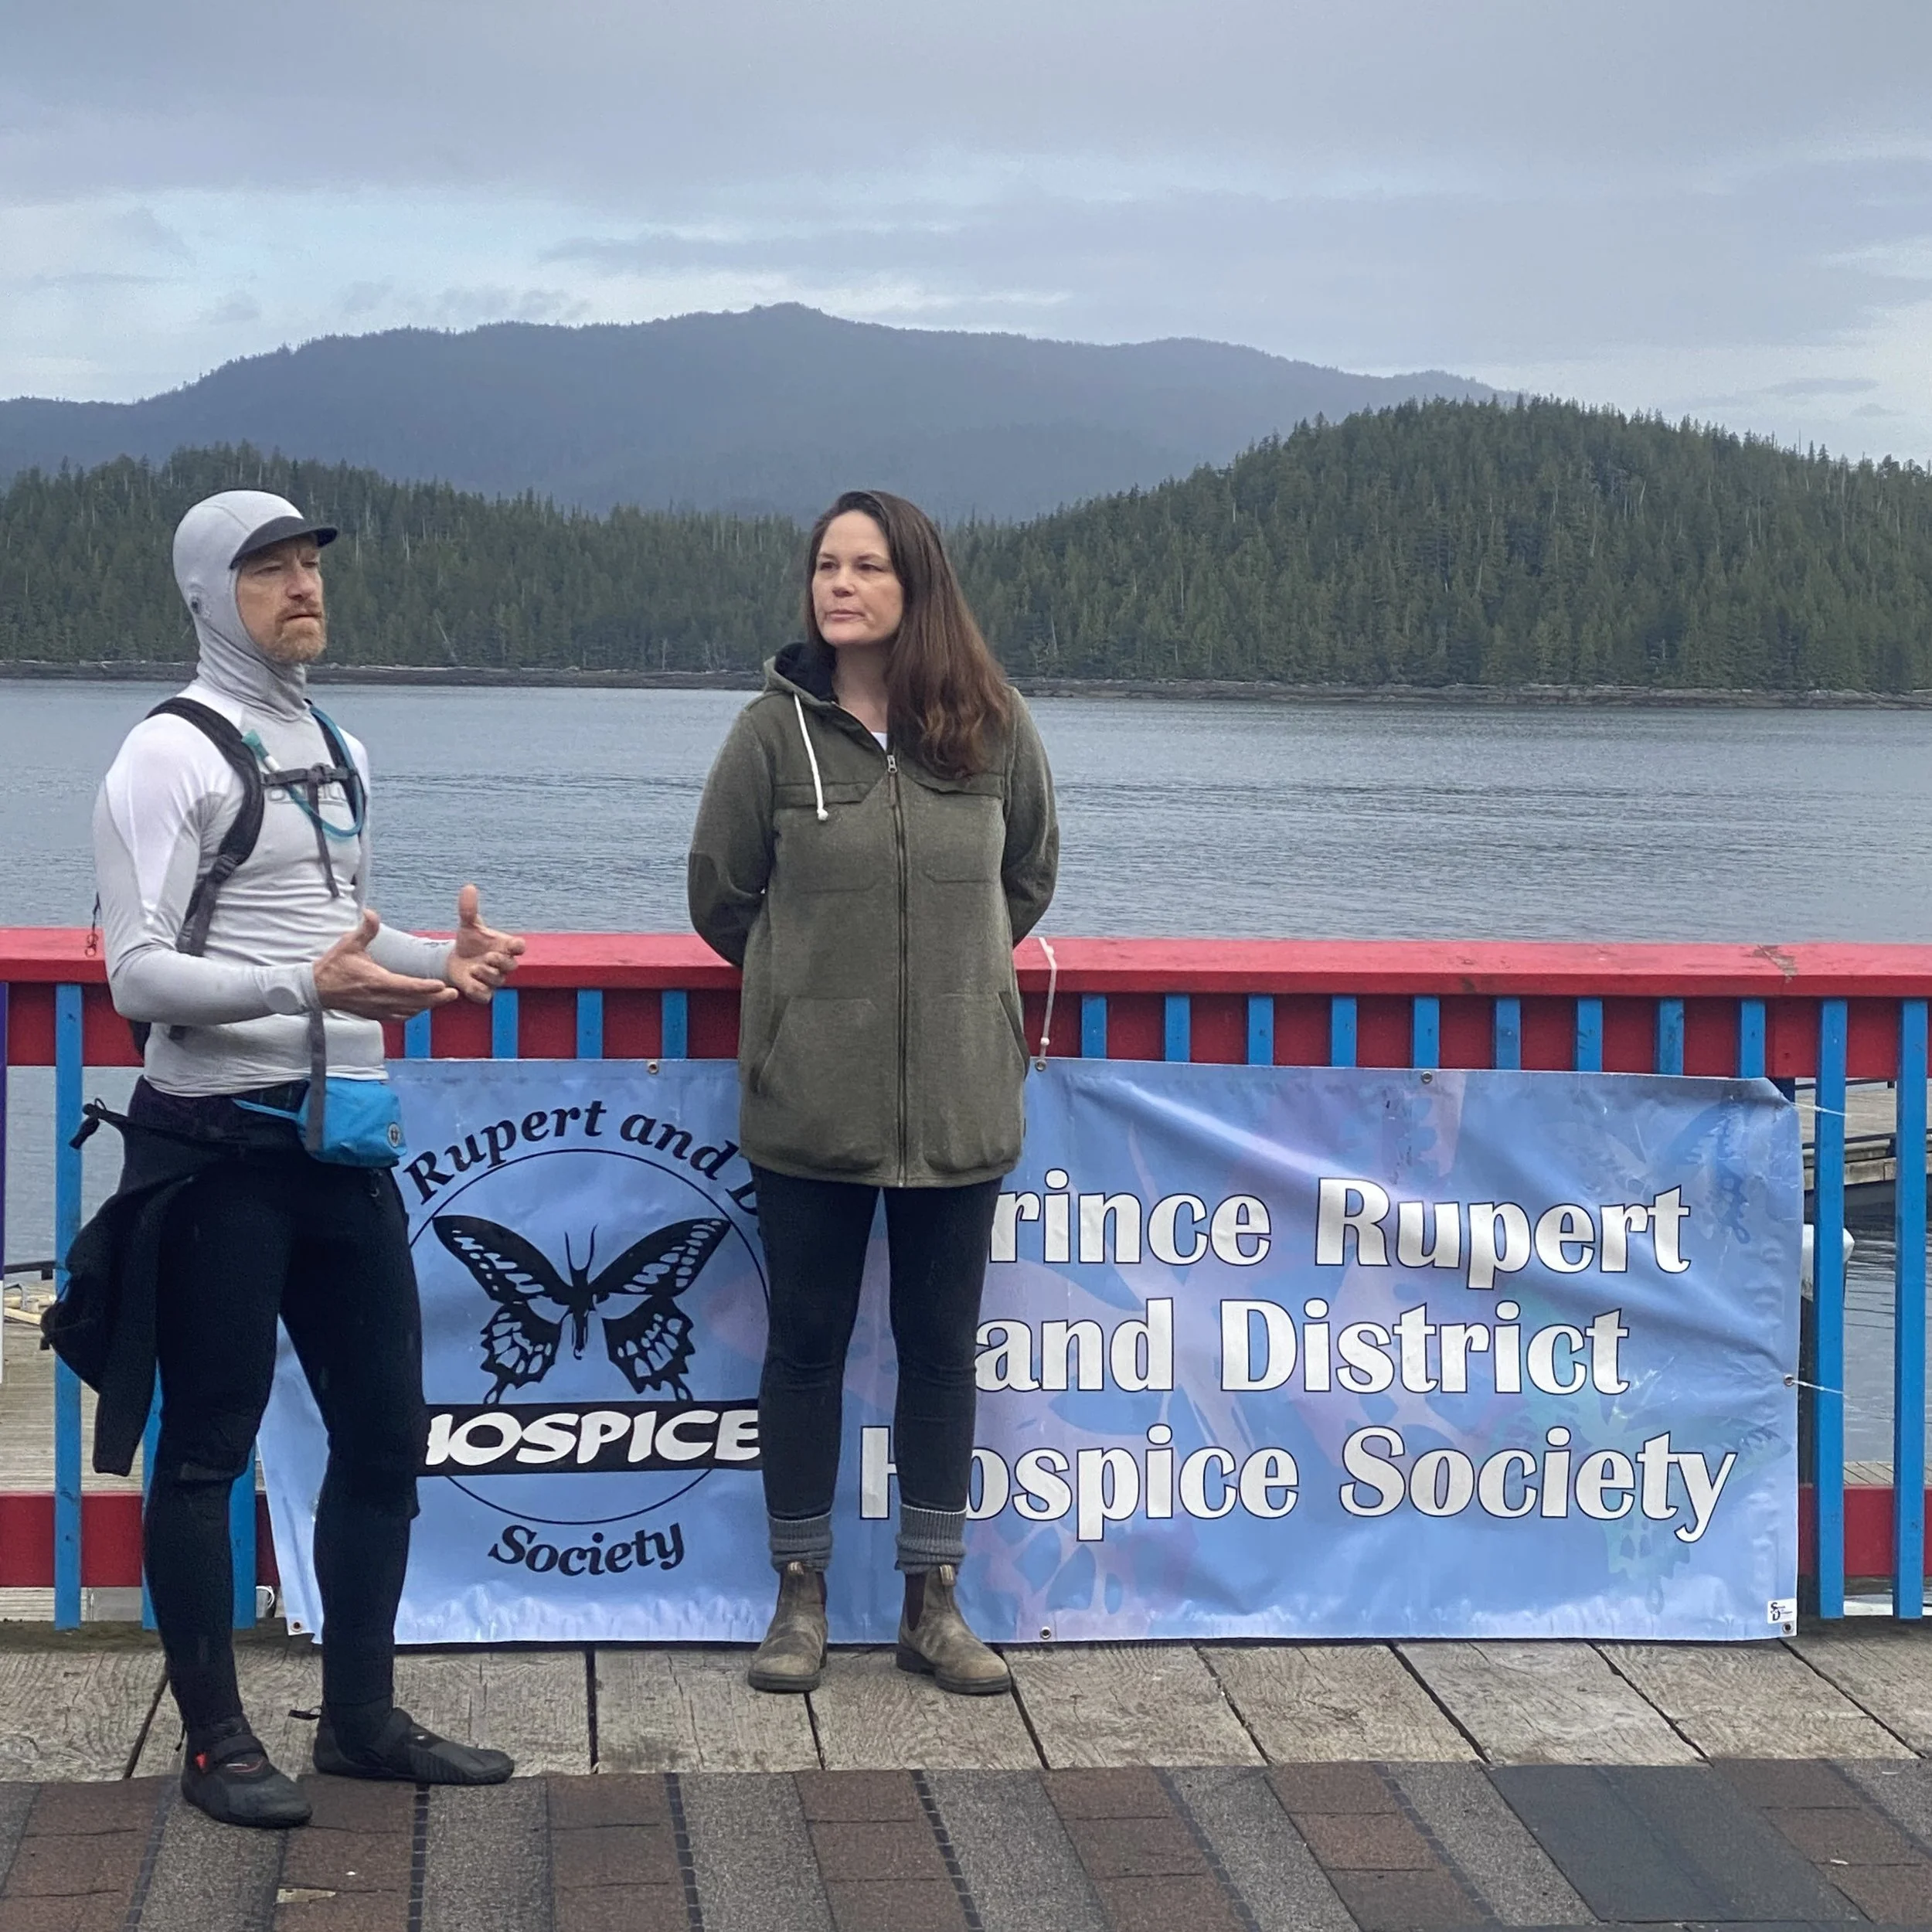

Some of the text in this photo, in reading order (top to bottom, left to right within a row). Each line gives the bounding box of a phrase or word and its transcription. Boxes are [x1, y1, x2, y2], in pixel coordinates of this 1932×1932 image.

[403, 1100, 740, 1206] Rupert and
[989, 1168, 1692, 1292] rince Rupert
[975, 1297, 1631, 1396] and District
[1338, 1424, 1739, 1544] Society
[488, 1522, 685, 1577] Society
